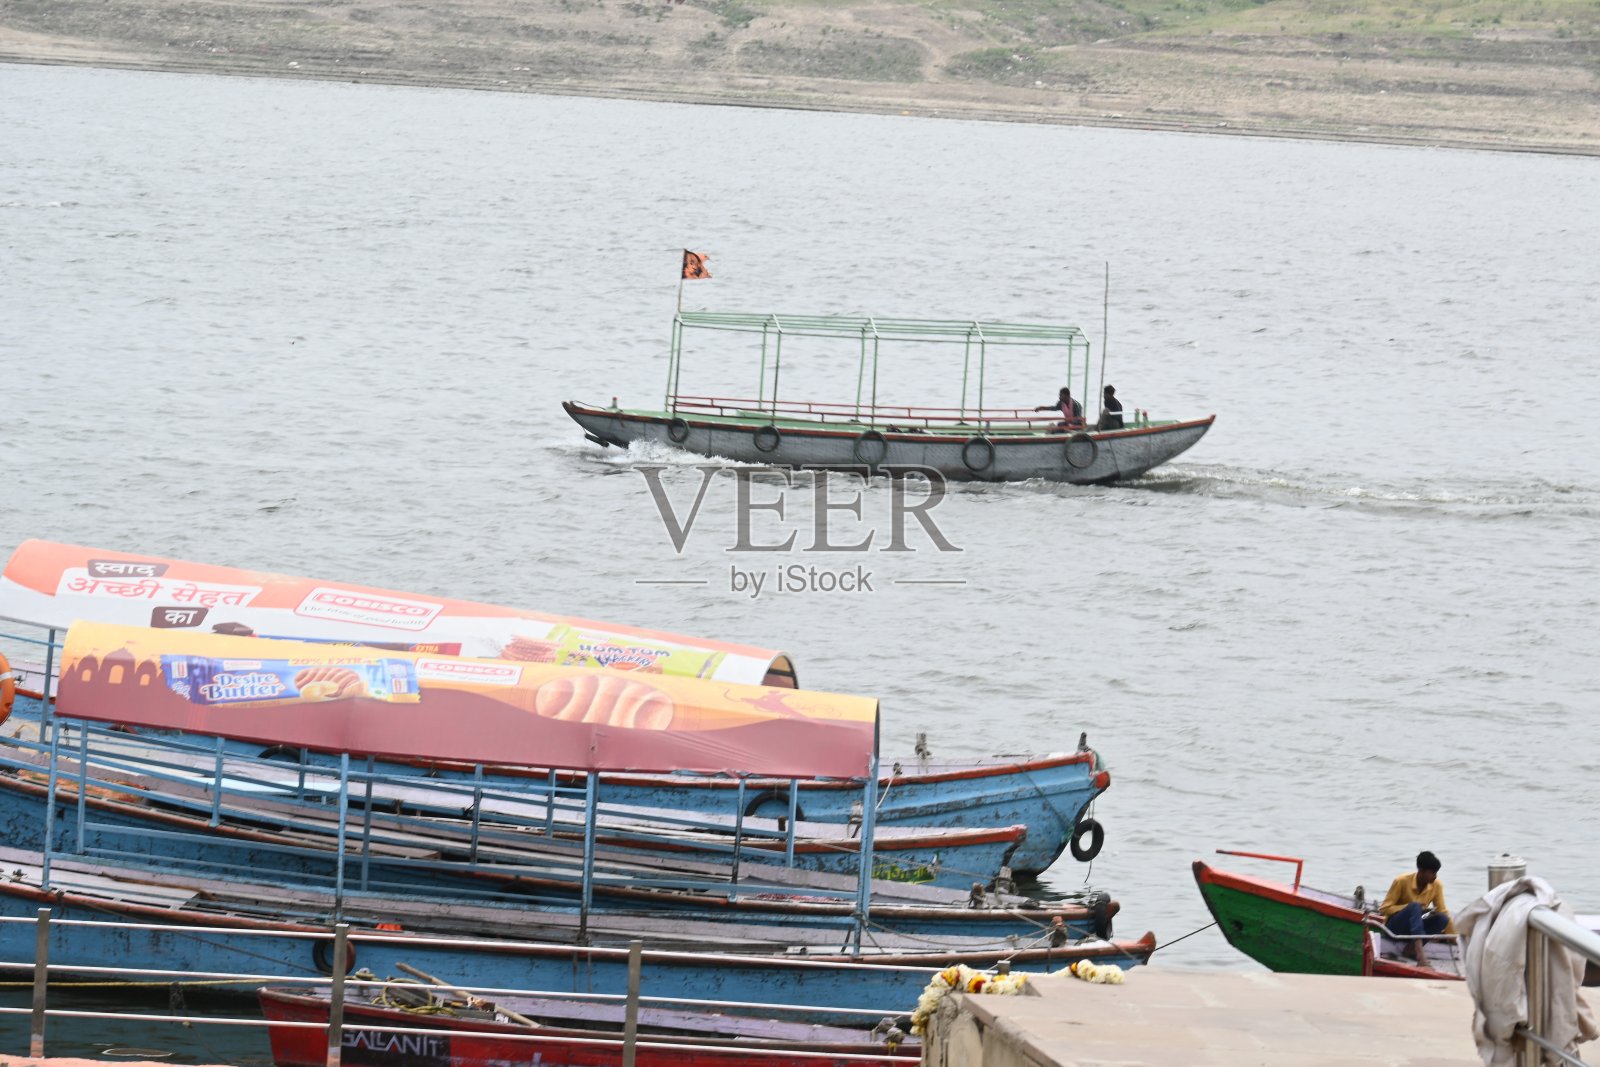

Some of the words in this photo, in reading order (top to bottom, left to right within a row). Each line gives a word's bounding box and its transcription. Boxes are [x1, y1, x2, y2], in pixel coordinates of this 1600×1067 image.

[94, 562, 157, 578] स्वाद
[67, 577, 164, 599] अच्छी
[171, 583, 250, 608] सेहत
[319, 594, 427, 616] SOBISCO
[164, 609, 199, 625] का
[327, 656, 373, 665] EXTRA
[426, 662, 512, 676] SOBISCO
[214, 672, 276, 687] Desire
[201, 683, 283, 700] Butter
